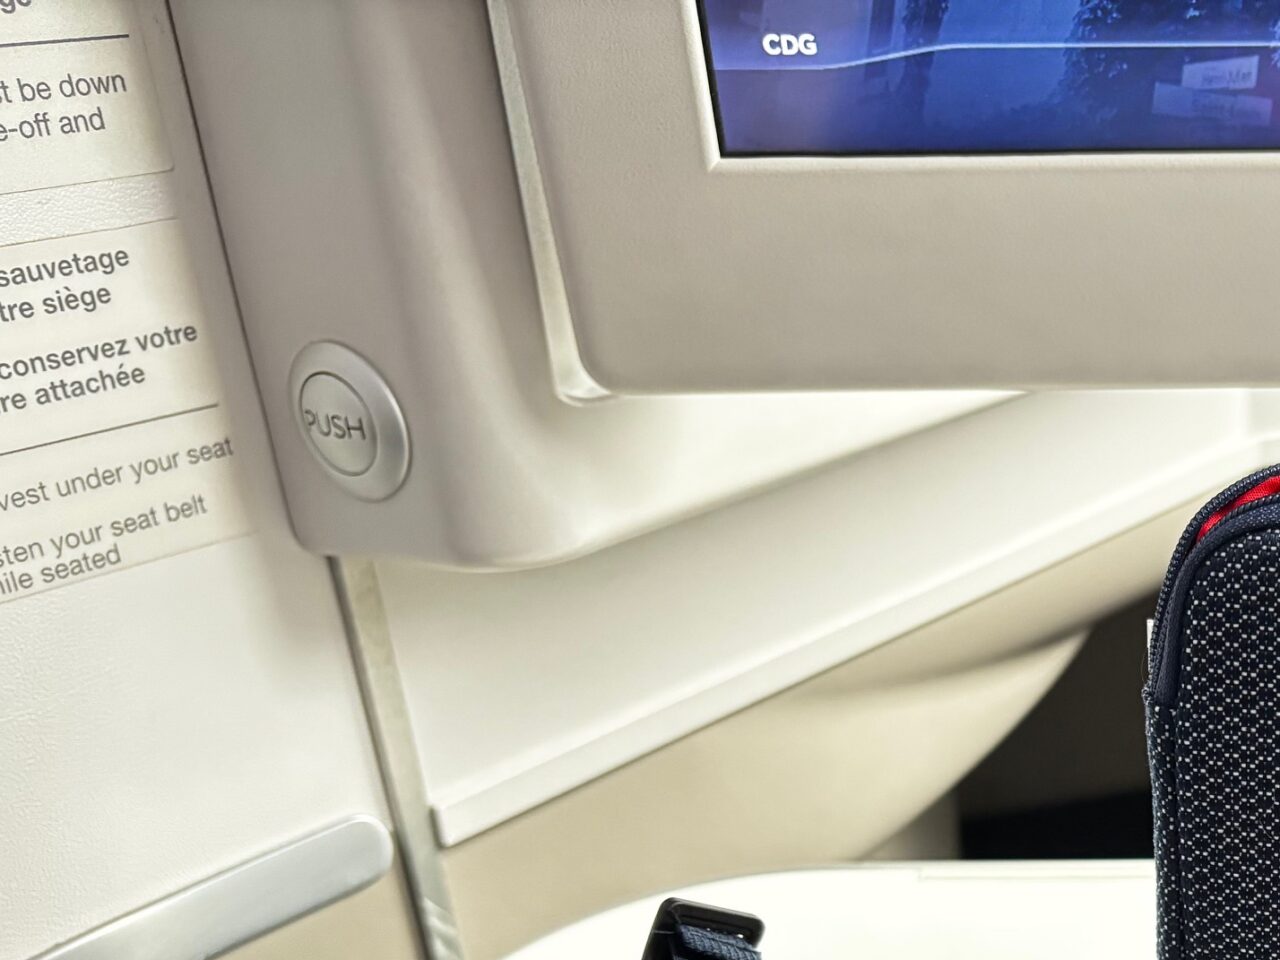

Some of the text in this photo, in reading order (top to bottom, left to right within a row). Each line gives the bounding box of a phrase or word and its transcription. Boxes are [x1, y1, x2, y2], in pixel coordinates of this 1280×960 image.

[762, 33, 818, 56] CDG
[16, 77, 52, 102] be
[58, 73, 128, 99] down
[58, 106, 106, 135] and
[0, 249, 130, 288] sauvetage
[42, 286, 112, 315] siège
[0, 325, 198, 380] conservez votre
[34, 363, 146, 405] attachée
[304, 409, 367, 440] PUSH
[55, 467, 123, 498] under
[127, 450, 180, 485] your
[186, 437, 234, 465] seat
[49, 524, 103, 560] your
[110, 506, 160, 537] seat
[163, 494, 208, 523] belt
[40, 542, 122, 584] seated
